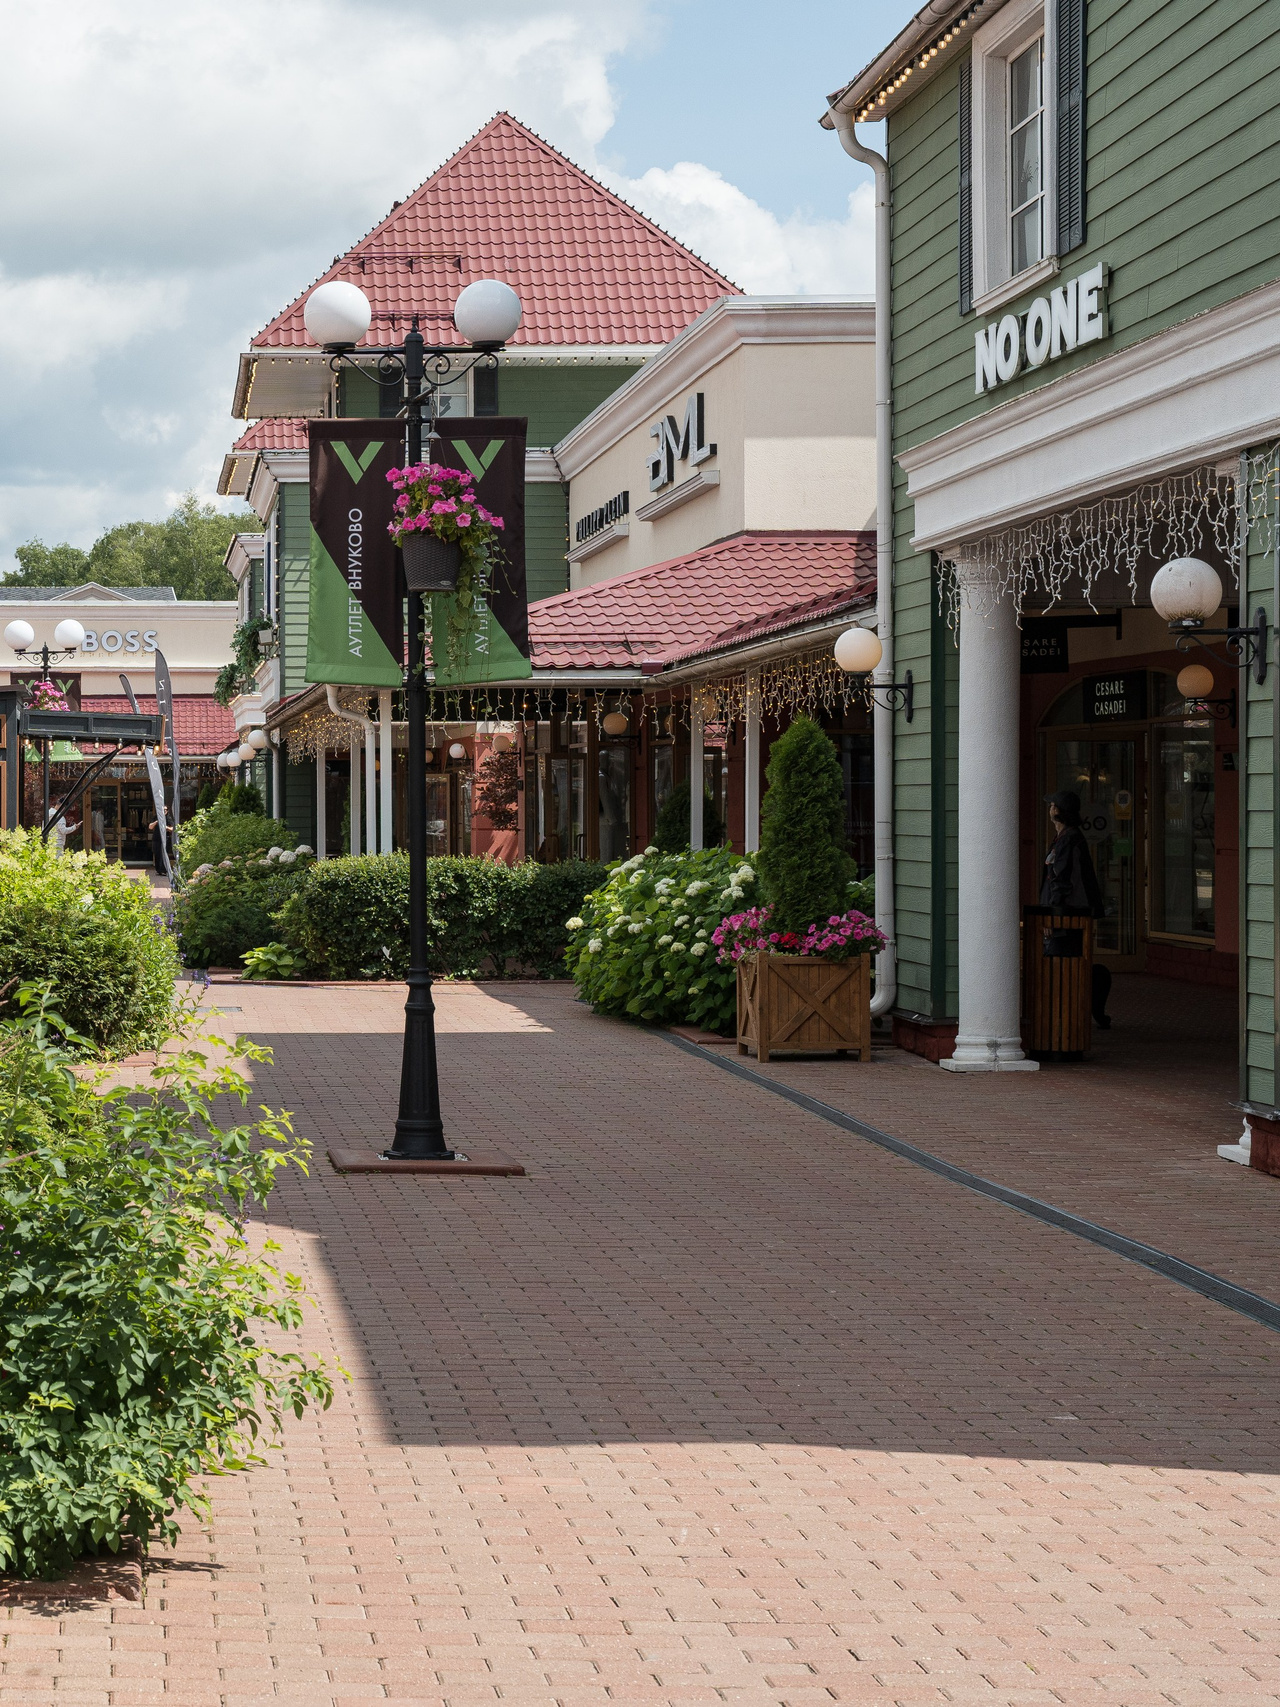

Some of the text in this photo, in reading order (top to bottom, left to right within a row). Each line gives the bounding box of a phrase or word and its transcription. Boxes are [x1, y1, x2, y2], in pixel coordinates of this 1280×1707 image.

[975, 262, 1107, 394] NO ONE
[348, 508, 363, 658] АУТЛЕТ ВНУКОВО
[81, 630, 159, 652] BOSS
[1023, 638, 1057, 647] SARE
[1021, 648, 1061, 657] SADEI
[1095, 680, 1124, 696] CESARE
[1094, 700, 1126, 716] CASADEI
